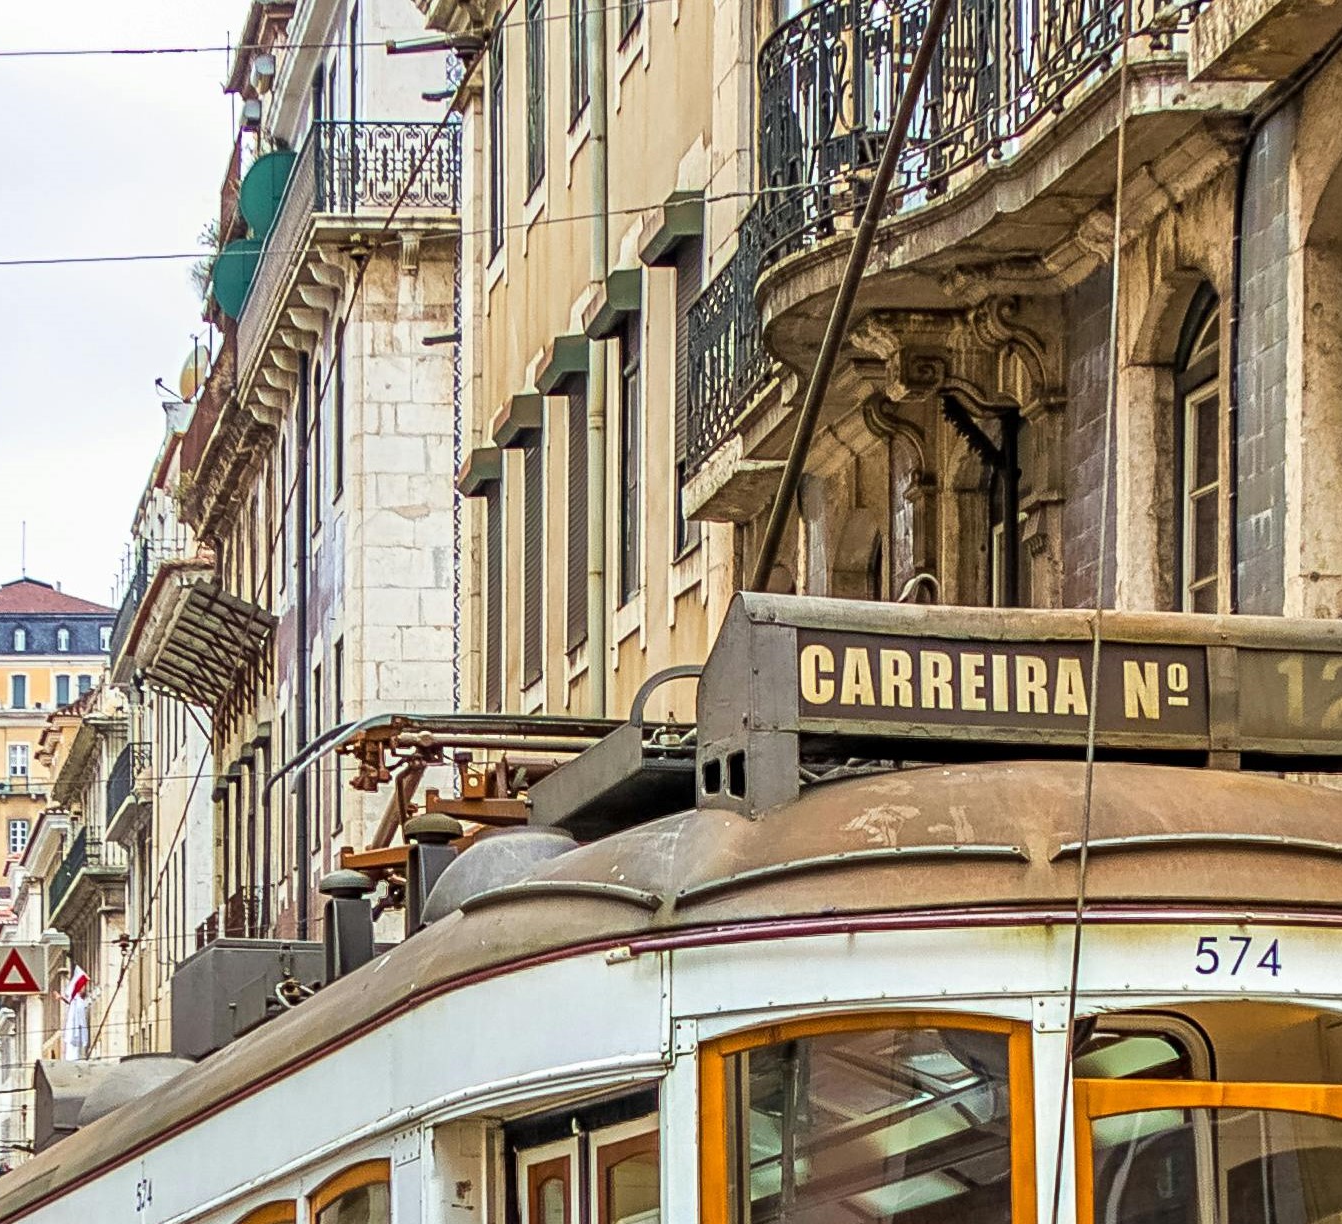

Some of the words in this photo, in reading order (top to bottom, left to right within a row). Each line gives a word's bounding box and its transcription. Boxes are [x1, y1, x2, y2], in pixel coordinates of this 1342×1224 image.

[800, 644, 1089, 716] CARREIRA
[1123, 660, 1190, 720] Nº
[1195, 936, 1282, 976] 574
